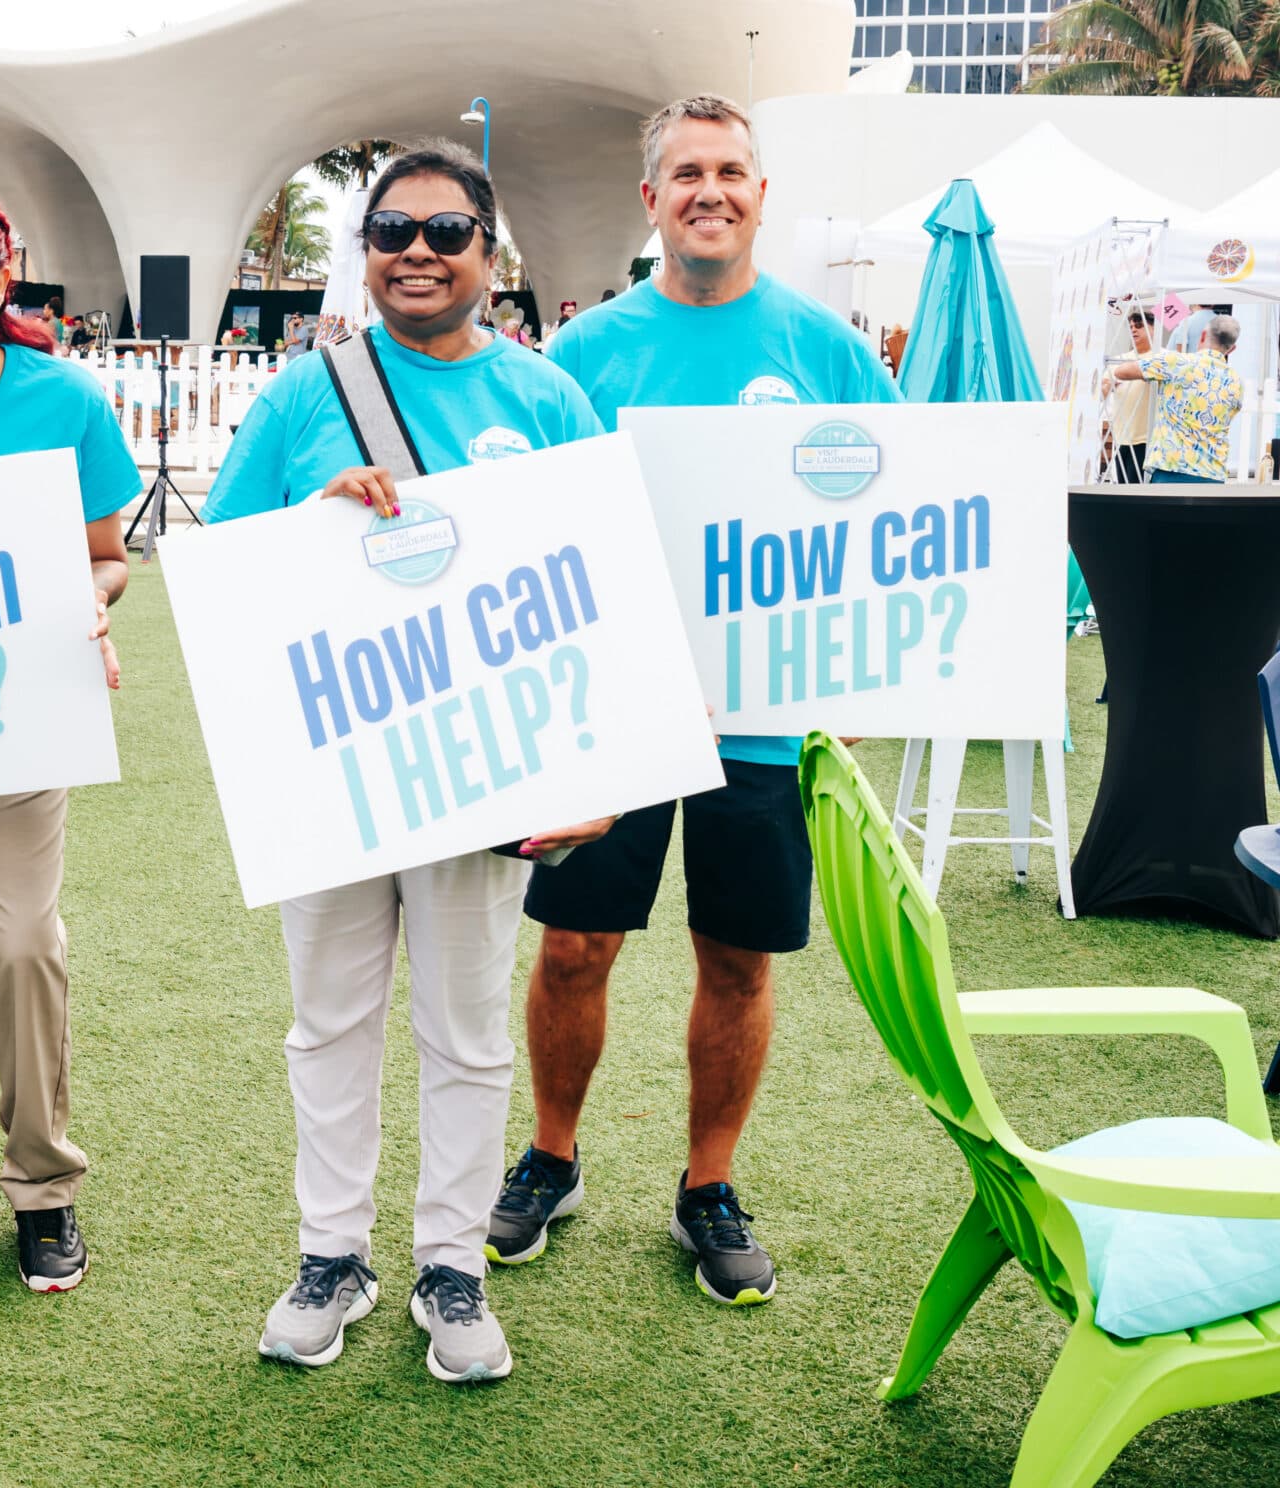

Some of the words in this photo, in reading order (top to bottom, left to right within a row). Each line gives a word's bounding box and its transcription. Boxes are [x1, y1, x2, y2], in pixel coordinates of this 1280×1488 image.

[1164, 304, 1179, 319] 41
[816, 455, 873, 465] LAUDERDALE
[817, 448, 838, 456] VISIT
[704, 518, 849, 618] How
[871, 495, 991, 587] can
[286, 603, 453, 750] How
[466, 544, 599, 668] can
[727, 621, 741, 713] I
[768, 584, 966, 705] HELP?
[339, 743, 380, 853] I
[382, 644, 595, 833] HELP?
